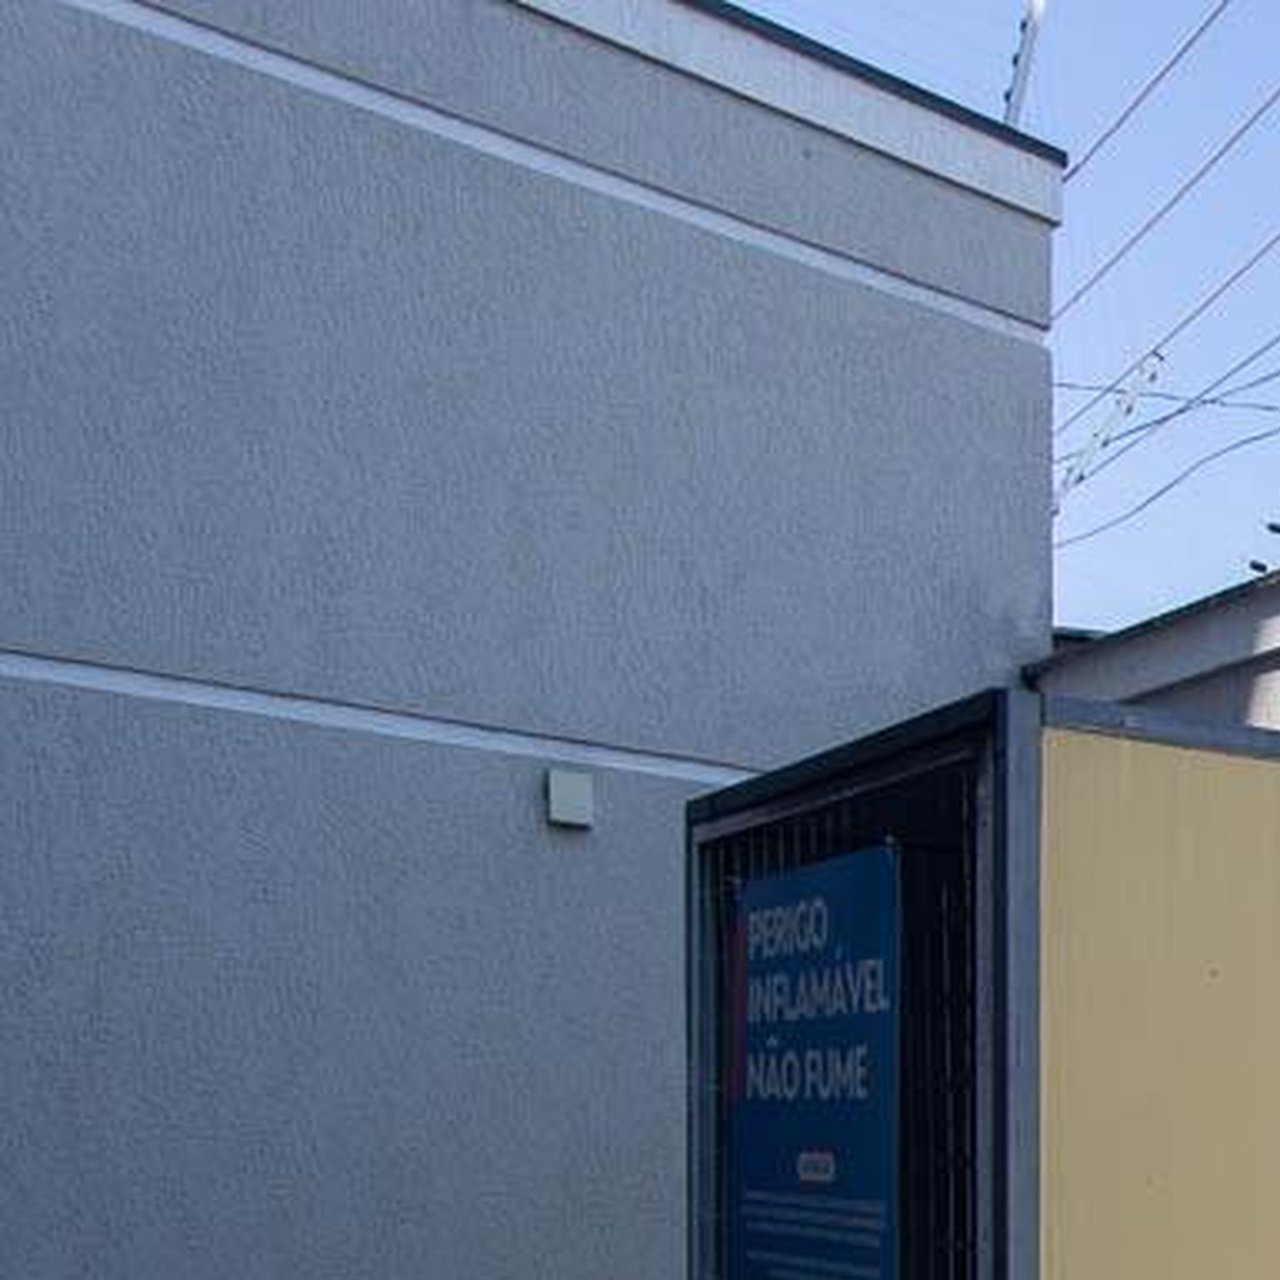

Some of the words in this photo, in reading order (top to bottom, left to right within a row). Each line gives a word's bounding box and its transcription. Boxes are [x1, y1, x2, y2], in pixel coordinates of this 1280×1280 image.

[748, 899, 828, 960] PERIGO
[747, 944, 890, 1021] INFLAMÁVEL
[745, 1034, 799, 1101] NÃO
[804, 1044, 869, 1100] FUME
